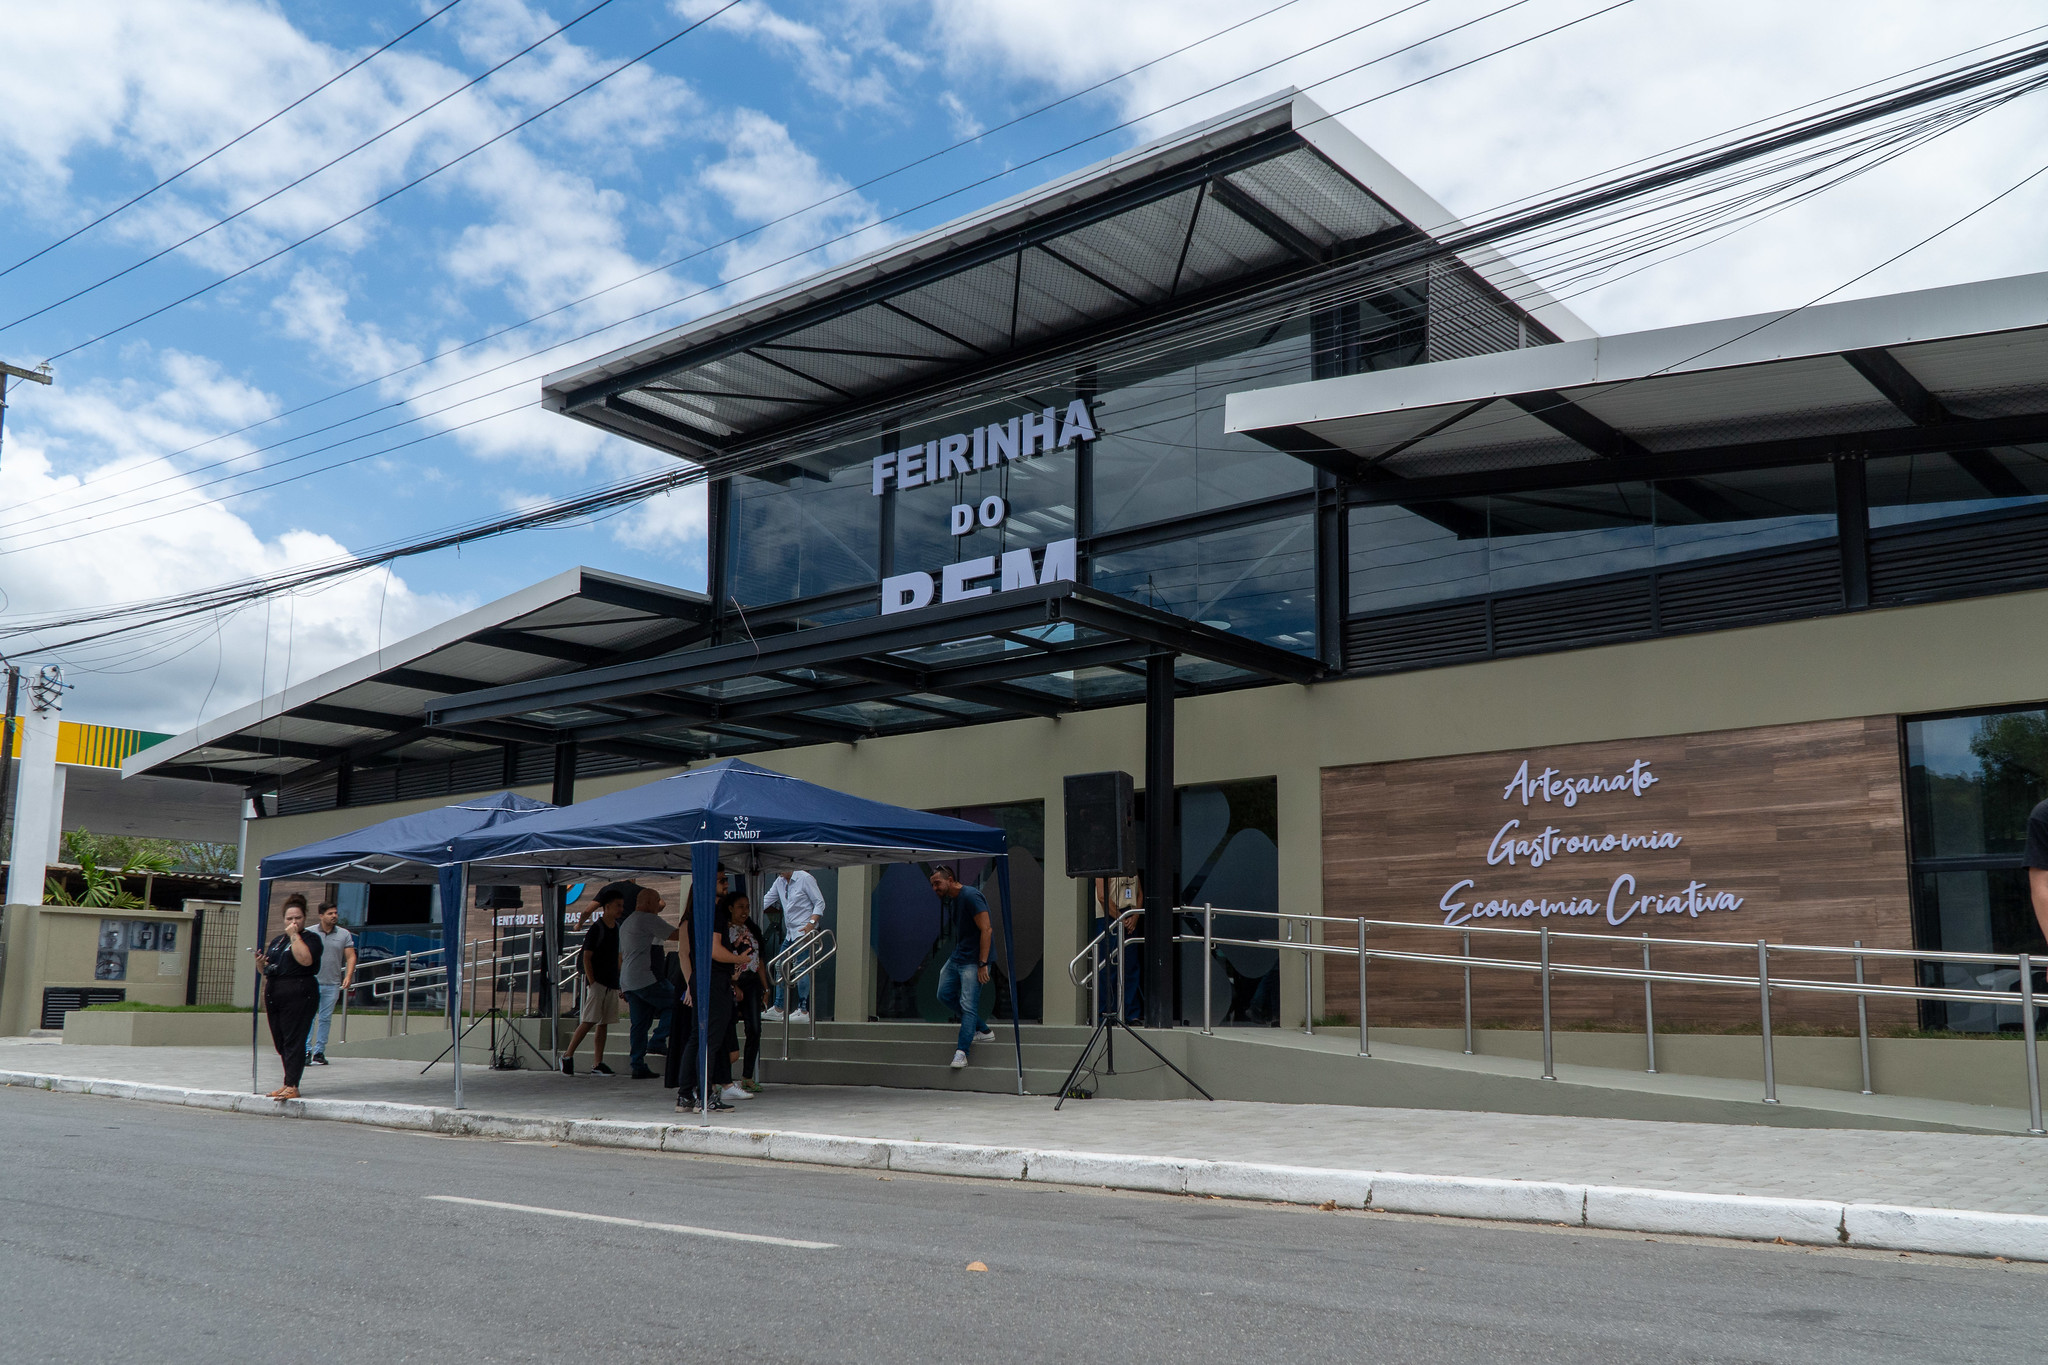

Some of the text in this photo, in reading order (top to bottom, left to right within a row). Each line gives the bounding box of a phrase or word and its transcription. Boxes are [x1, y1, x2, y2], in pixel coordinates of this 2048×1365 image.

[872, 399, 1097, 496] FEIRINHA
[951, 495, 1006, 536] DO
[1503, 759, 1660, 808] Artesanato
[724, 830, 761, 840] SCHMIDT
[1487, 819, 1683, 868] Gastronomia
[527, 914, 539, 925] DE
[1439, 873, 1745, 926] Economia Criativa
